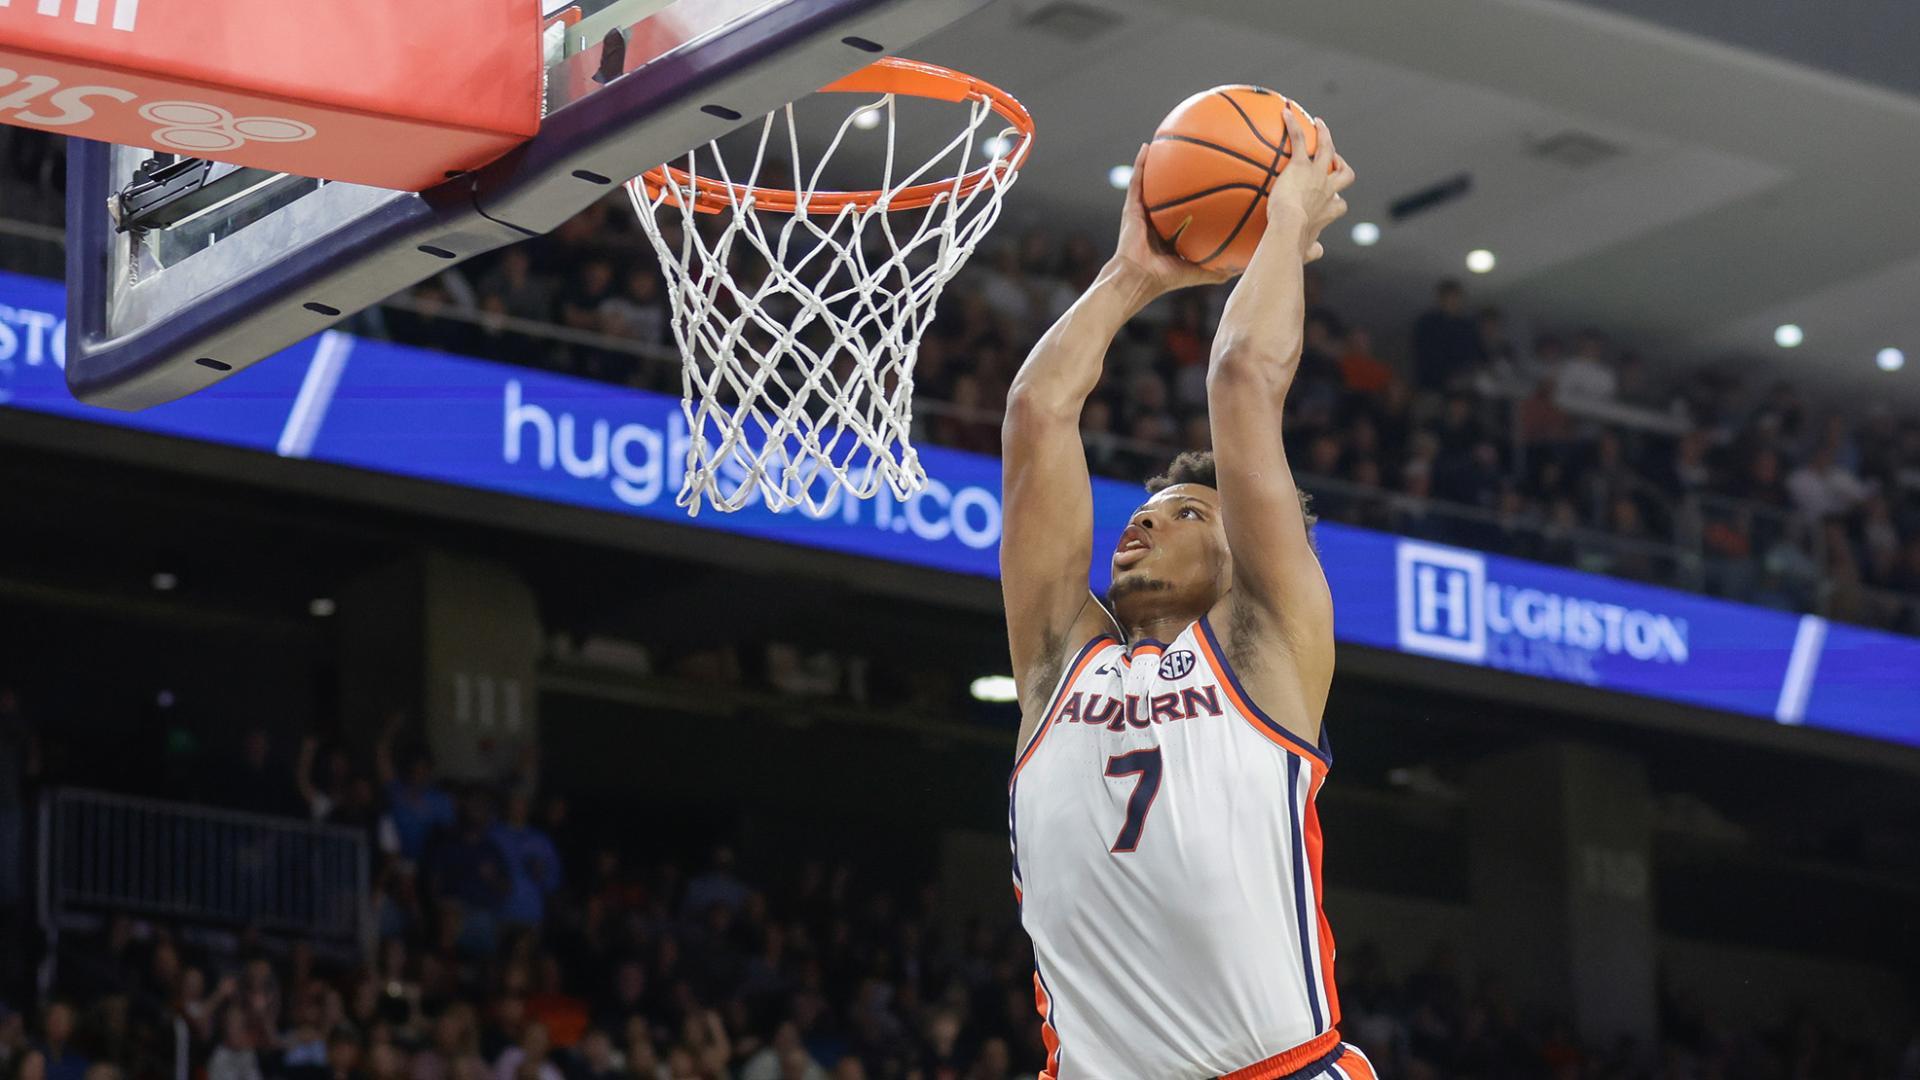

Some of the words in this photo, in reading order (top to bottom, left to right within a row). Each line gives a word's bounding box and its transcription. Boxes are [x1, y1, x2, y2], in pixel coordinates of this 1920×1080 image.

[0, 67, 139, 126] St
[1159, 650, 1195, 680] SEC
[1104, 745, 1163, 853] 7
